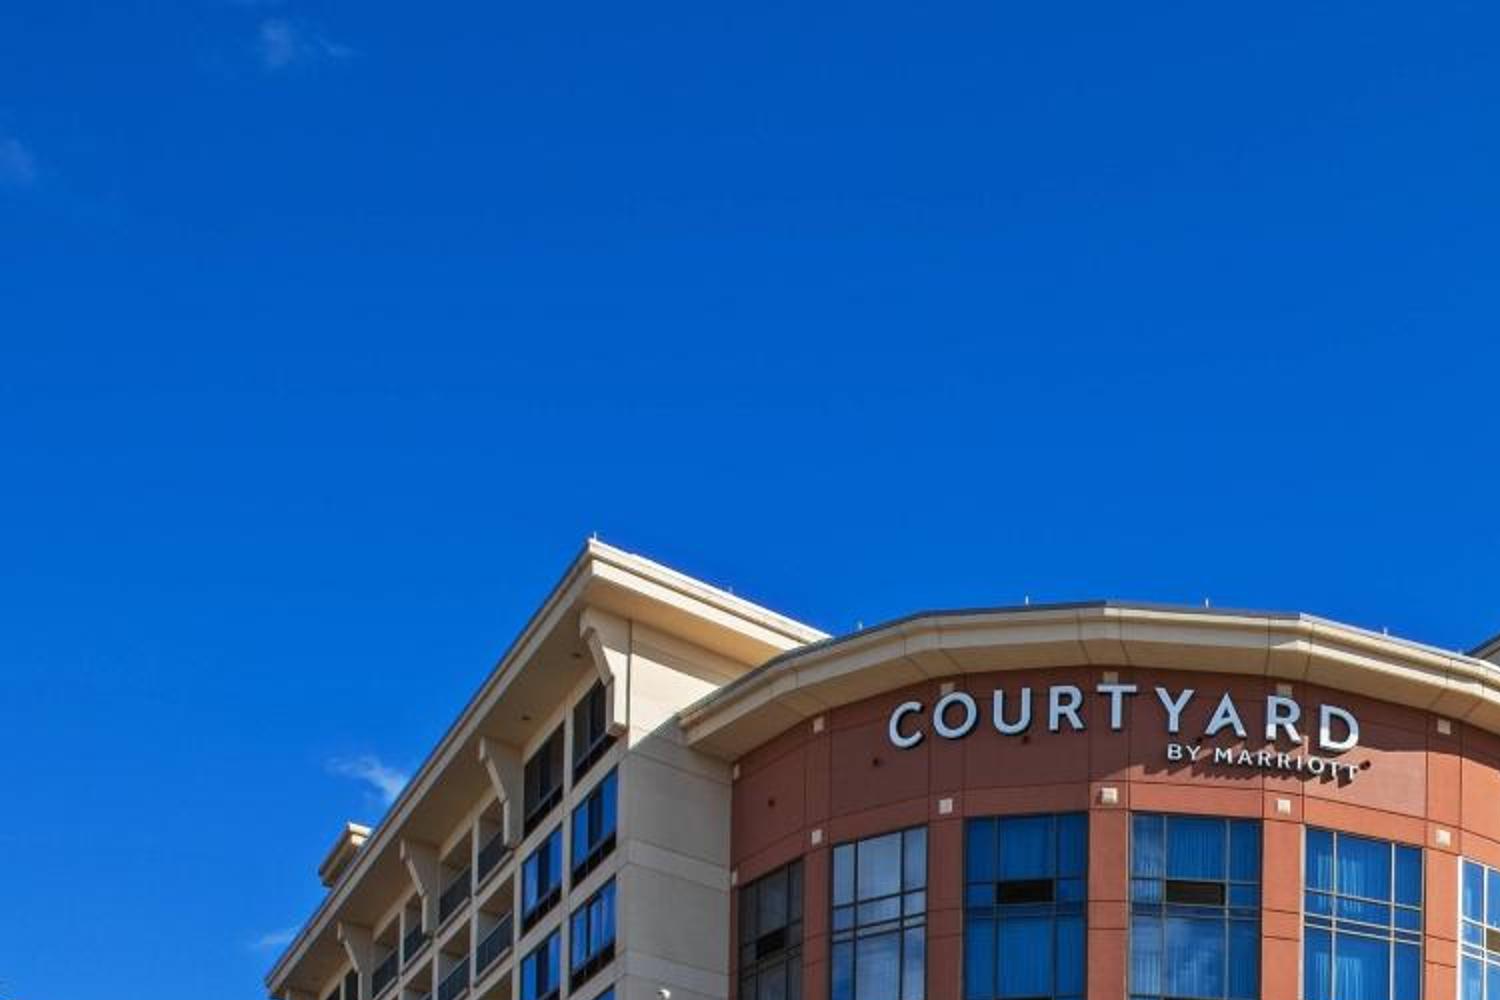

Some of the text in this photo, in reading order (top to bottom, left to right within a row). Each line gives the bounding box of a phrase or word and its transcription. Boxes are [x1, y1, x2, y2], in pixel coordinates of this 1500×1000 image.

[888, 683, 1360, 753] COURTYARD
[1167, 743, 1359, 780] BY MARRIOTT
